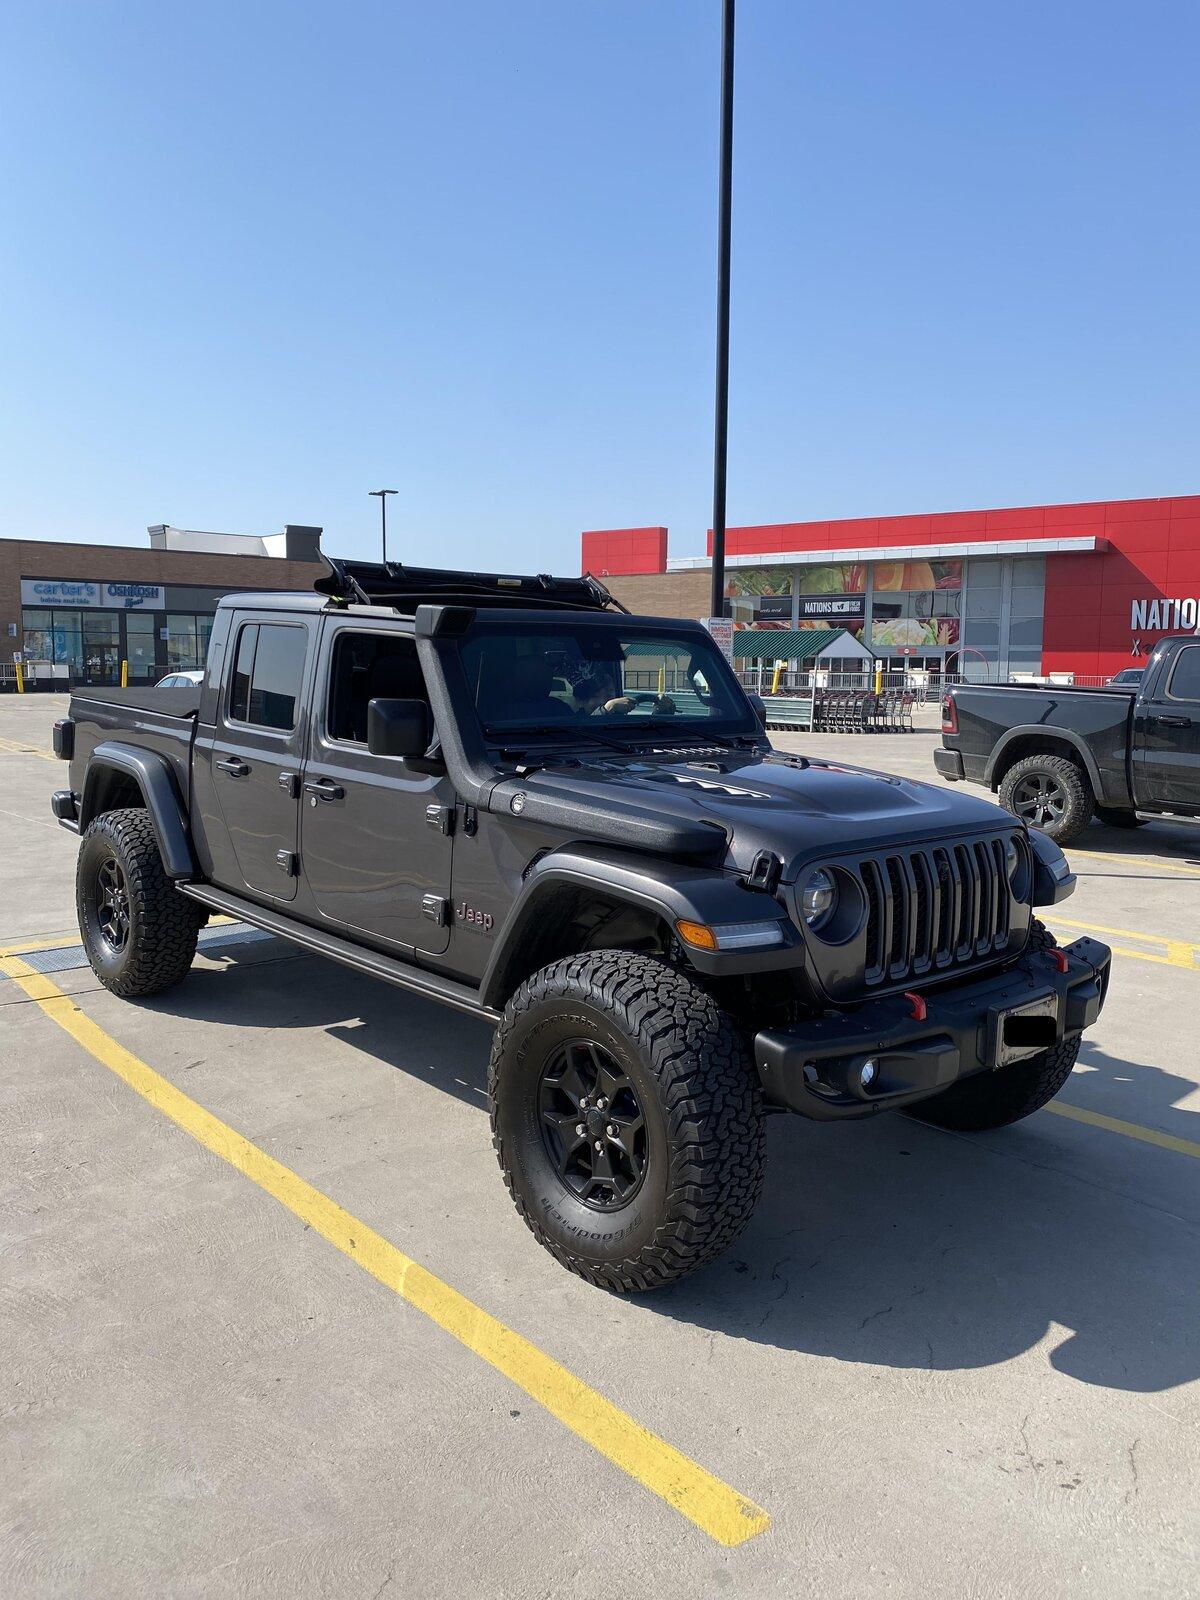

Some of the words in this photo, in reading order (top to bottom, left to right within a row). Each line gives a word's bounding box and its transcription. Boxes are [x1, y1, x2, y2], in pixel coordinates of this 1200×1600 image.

[33, 583, 96, 597] carter's
[804, 602, 832, 614] NATIONS
[1131, 598, 1200, 630] NATIO
[457, 902, 493, 931] Jeep
